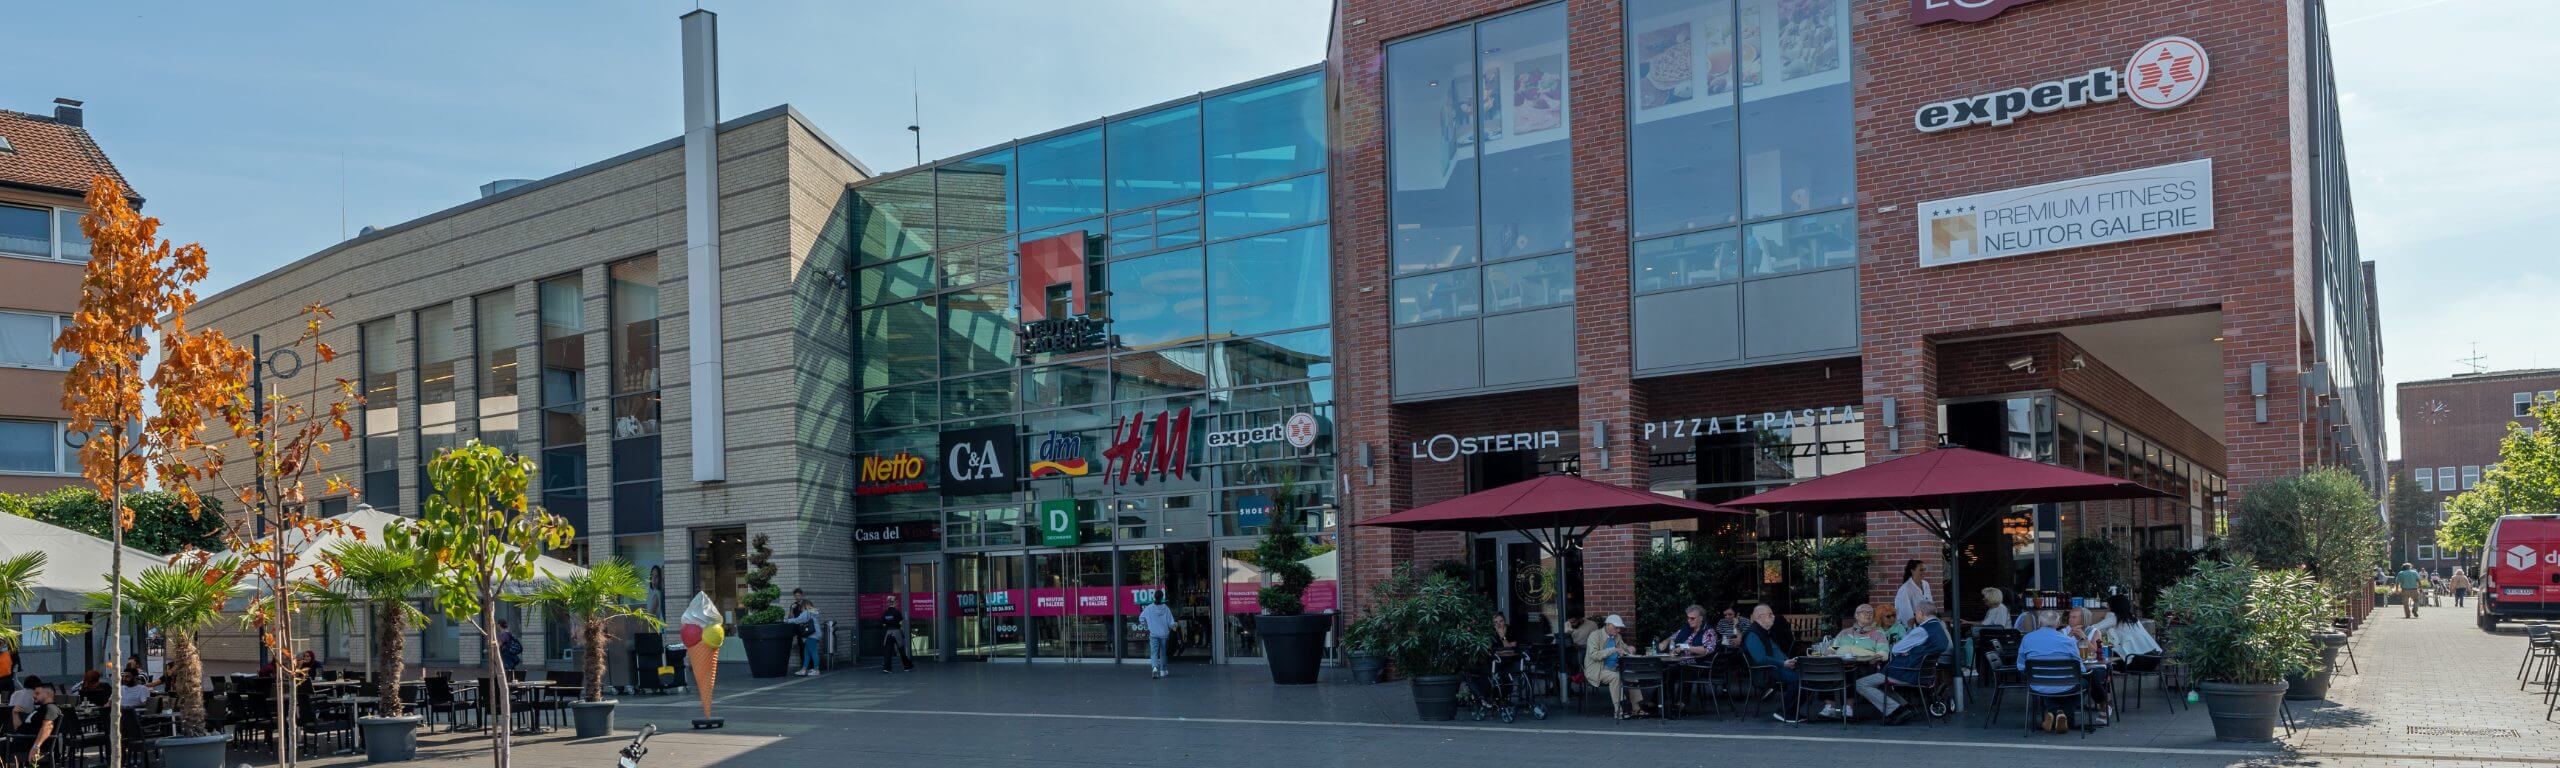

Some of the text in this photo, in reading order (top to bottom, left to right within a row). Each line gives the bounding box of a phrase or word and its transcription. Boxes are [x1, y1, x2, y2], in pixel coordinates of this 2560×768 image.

[1918, 70, 2114, 129] expert
[1984, 180, 2197, 229] PREMIUM FITNESS
[1985, 206, 2198, 253] NEUTOR GALERIE
[1208, 424, 1284, 447] expert
[1645, 405, 1856, 440] PIZZA E PASTA
[949, 439, 1004, 482] C&A
[1039, 429, 1082, 461] dm
[1102, 406, 1193, 486] H&M
[861, 451, 924, 483] Netto
[855, 528, 881, 542] Casa
[882, 526, 900, 540] del
[1050, 510, 1069, 533] D
